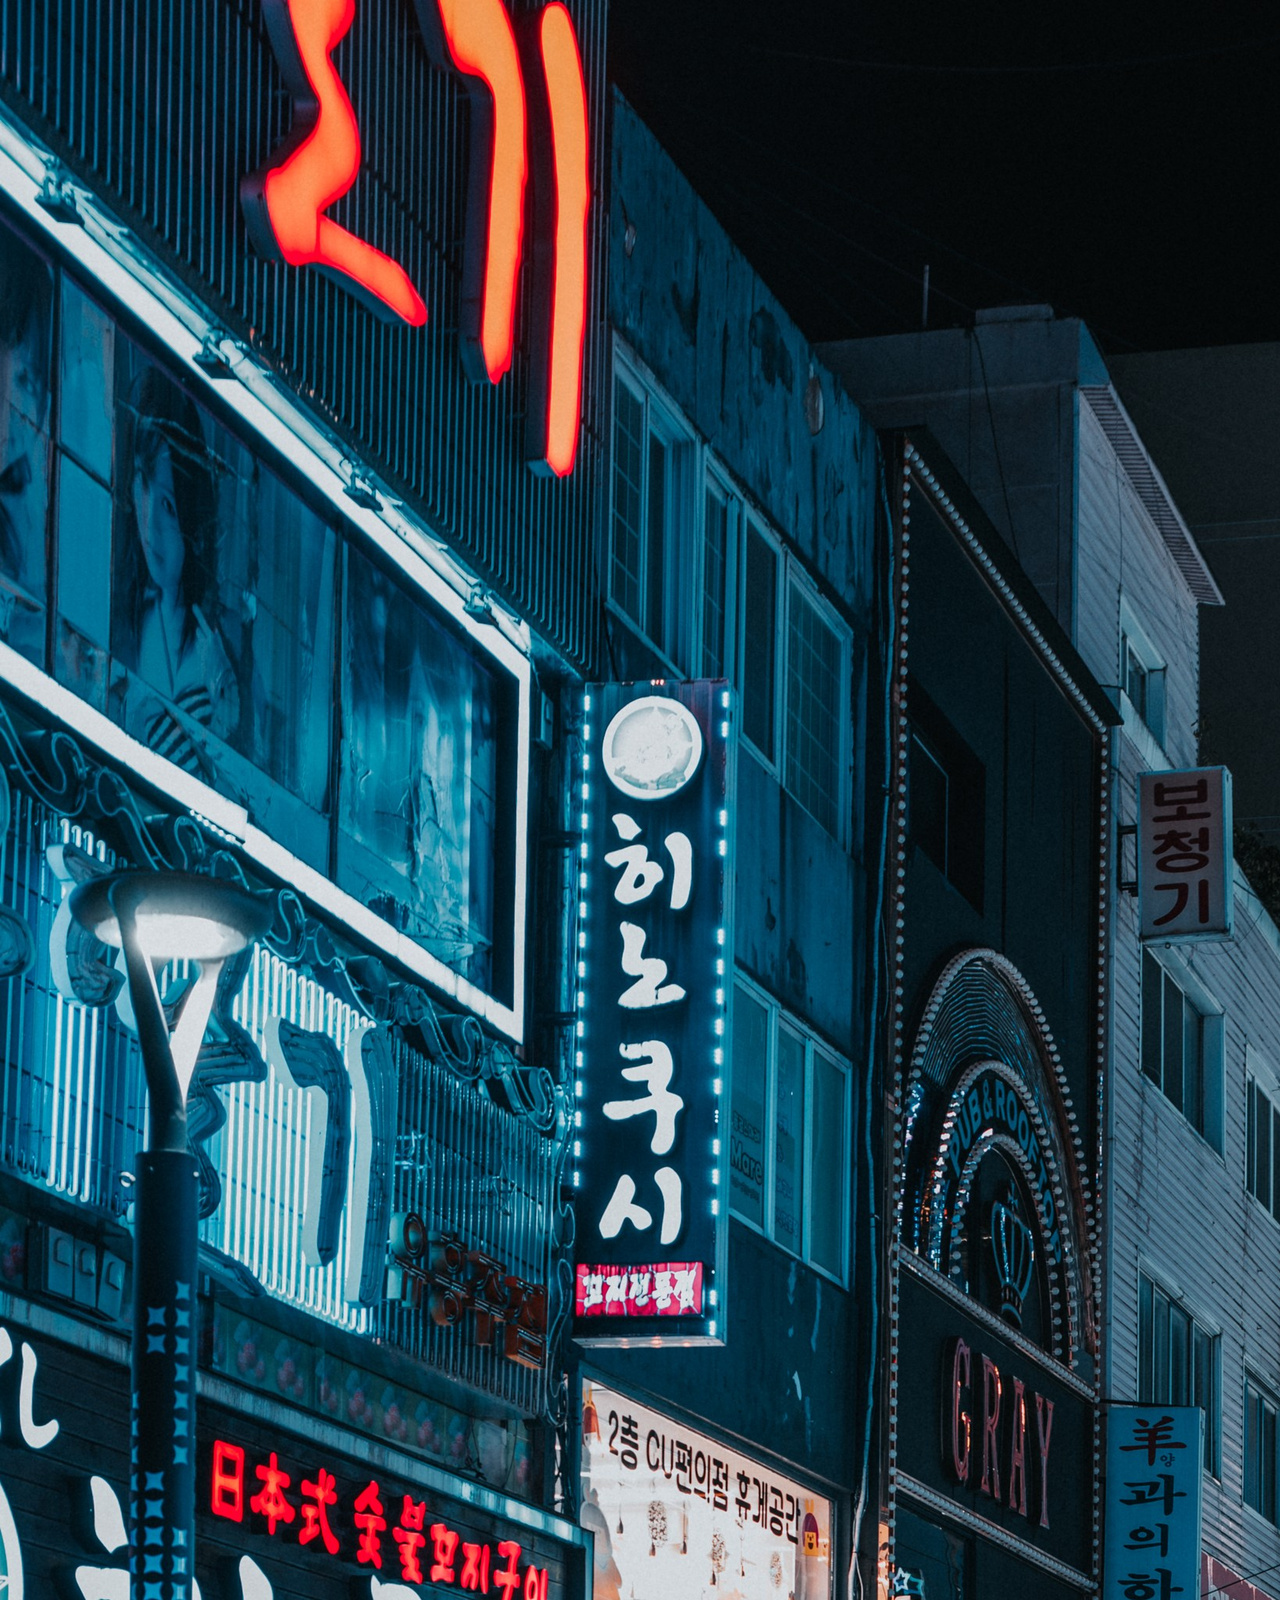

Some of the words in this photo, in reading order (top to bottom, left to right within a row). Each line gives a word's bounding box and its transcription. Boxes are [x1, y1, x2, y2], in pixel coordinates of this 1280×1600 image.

[1152, 779, 1211, 927] 보청기
[599, 812, 693, 1246] 히노쿠시
[949, 1087, 982, 1180] PUB
[211, 1440, 340, 1555] 日本式
[608, 1410, 640, 1470] 2층
[646, 1430, 729, 1513] CU편의점
[736, 1468, 801, 1546] 휴게공간
[950, 1337, 1055, 1529] GRAY
